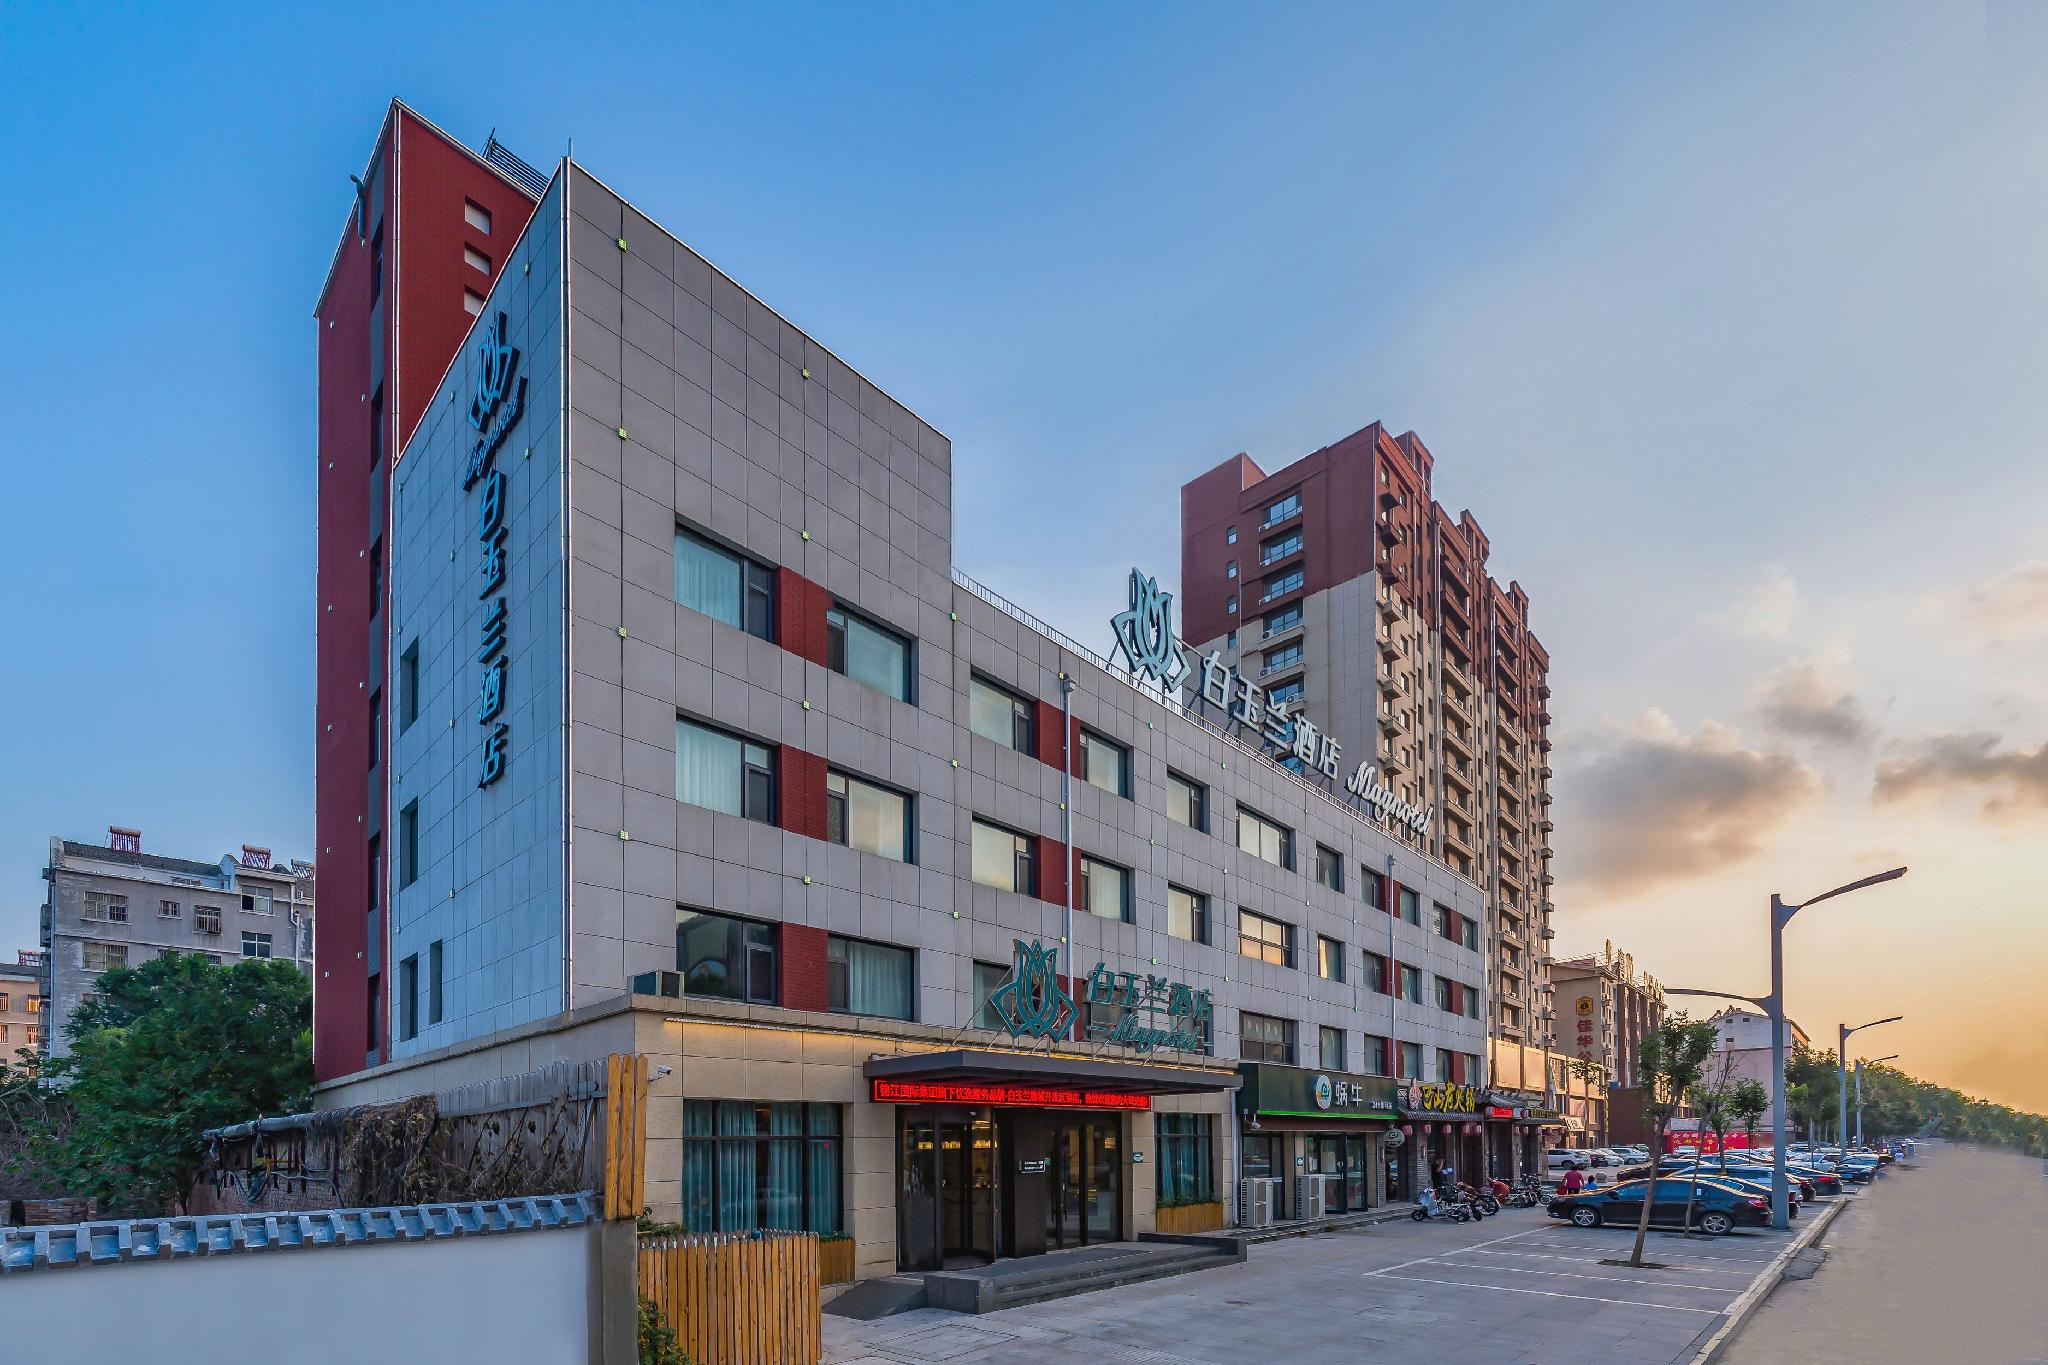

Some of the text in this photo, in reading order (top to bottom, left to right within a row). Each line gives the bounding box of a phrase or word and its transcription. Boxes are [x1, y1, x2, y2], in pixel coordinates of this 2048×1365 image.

[478, 469, 508, 789] 白玉兰酒店
[1202, 650, 1342, 780] 白玉兰酒店
[1346, 761, 1434, 836] Magnotel
[1087, 962, 1214, 1021] 白玉兰酒店
[1110, 1014, 1201, 1053] Magnotel
[1335, 1081, 1363, 1107] 蜗牛
